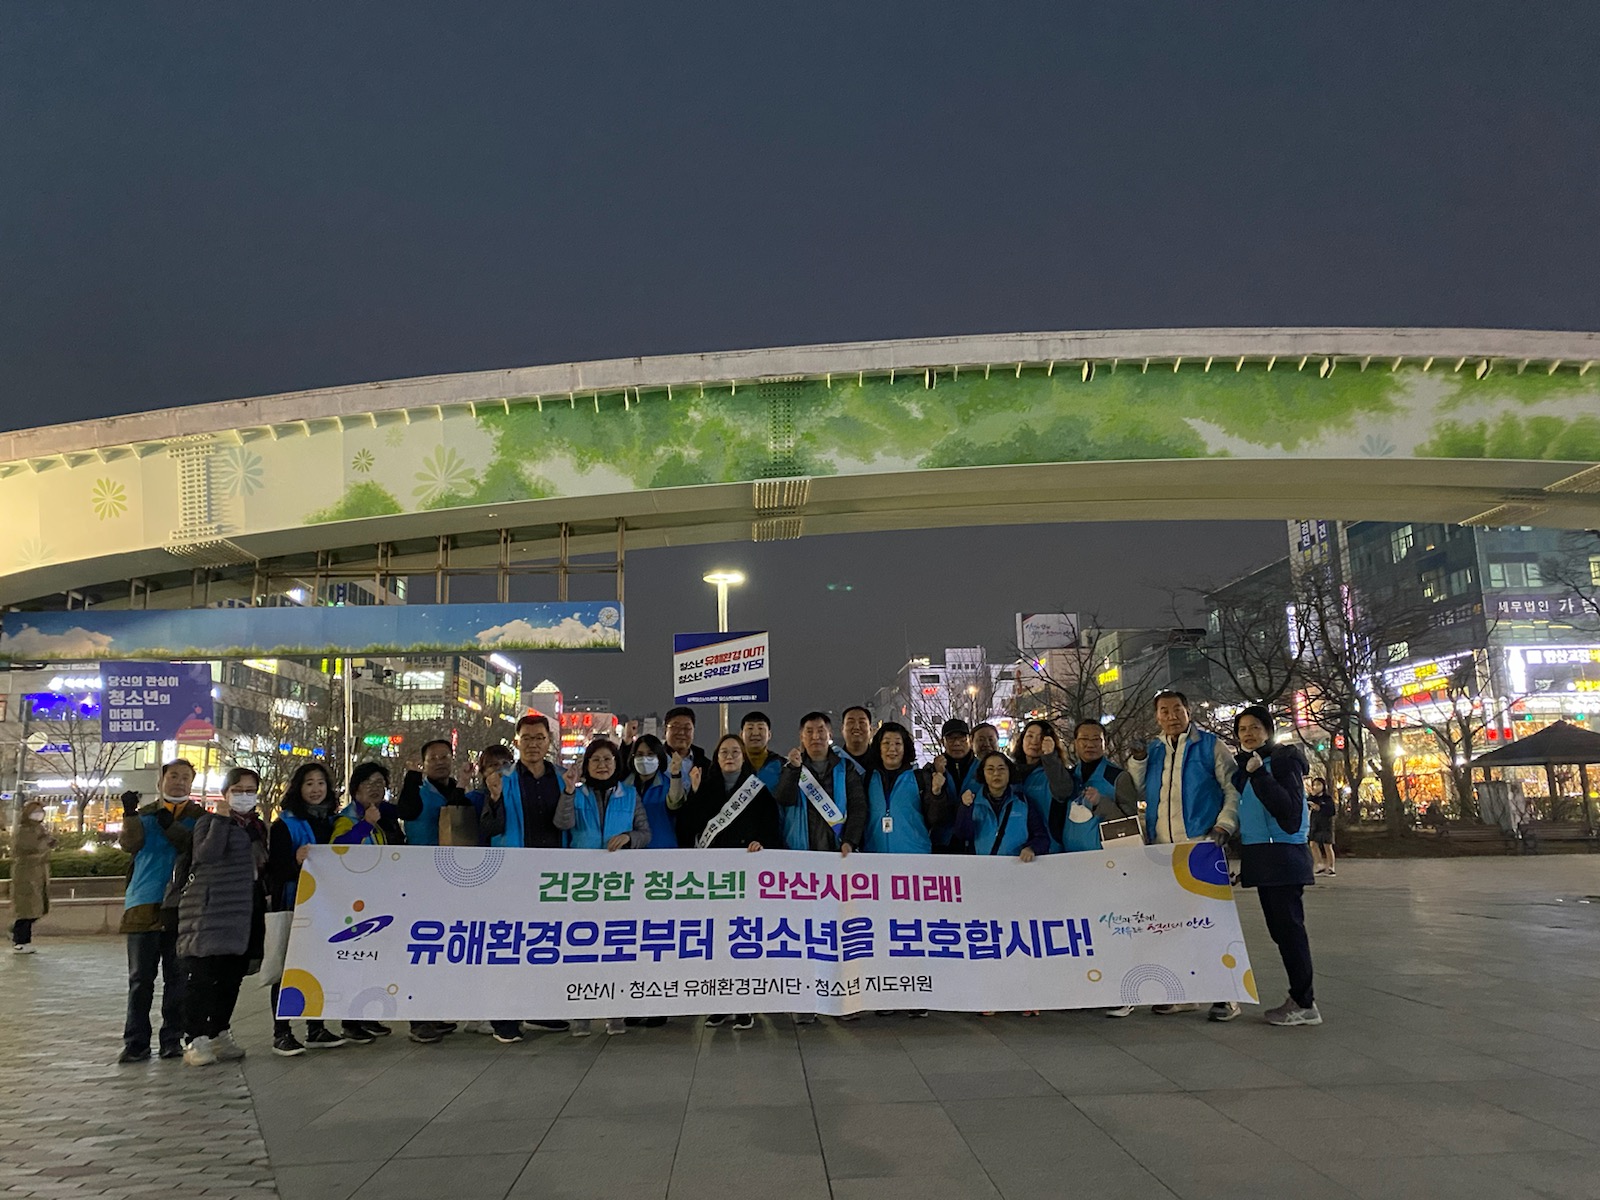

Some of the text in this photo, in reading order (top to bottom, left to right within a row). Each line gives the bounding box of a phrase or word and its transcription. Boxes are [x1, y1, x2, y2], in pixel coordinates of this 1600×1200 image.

[1498, 600, 1549, 613] 세무법인
[680, 645, 765, 671] 청소년 유해환경 OUT!
[678, 658, 764, 684] 청소년 유익환경 YES!
[108, 675, 143, 687] 당신의
[146, 675, 179, 687] 관심이
[108, 689, 171, 705] 청소년의
[109, 708, 144, 719] 미래를
[109, 720, 160, 732] 바꿉니다.
[539, 870, 961, 903] 건강한 청소년! 안산시의 미래!
[1186, 916, 1216, 930] 안산
[407, 916, 1092, 966] 유해환경으로부터 청소년을 보호합시다!
[336, 949, 379, 961] 안산시
[566, 974, 933, 1001] 안산시 청소년 유해환경감시단 청소년 지도위원
